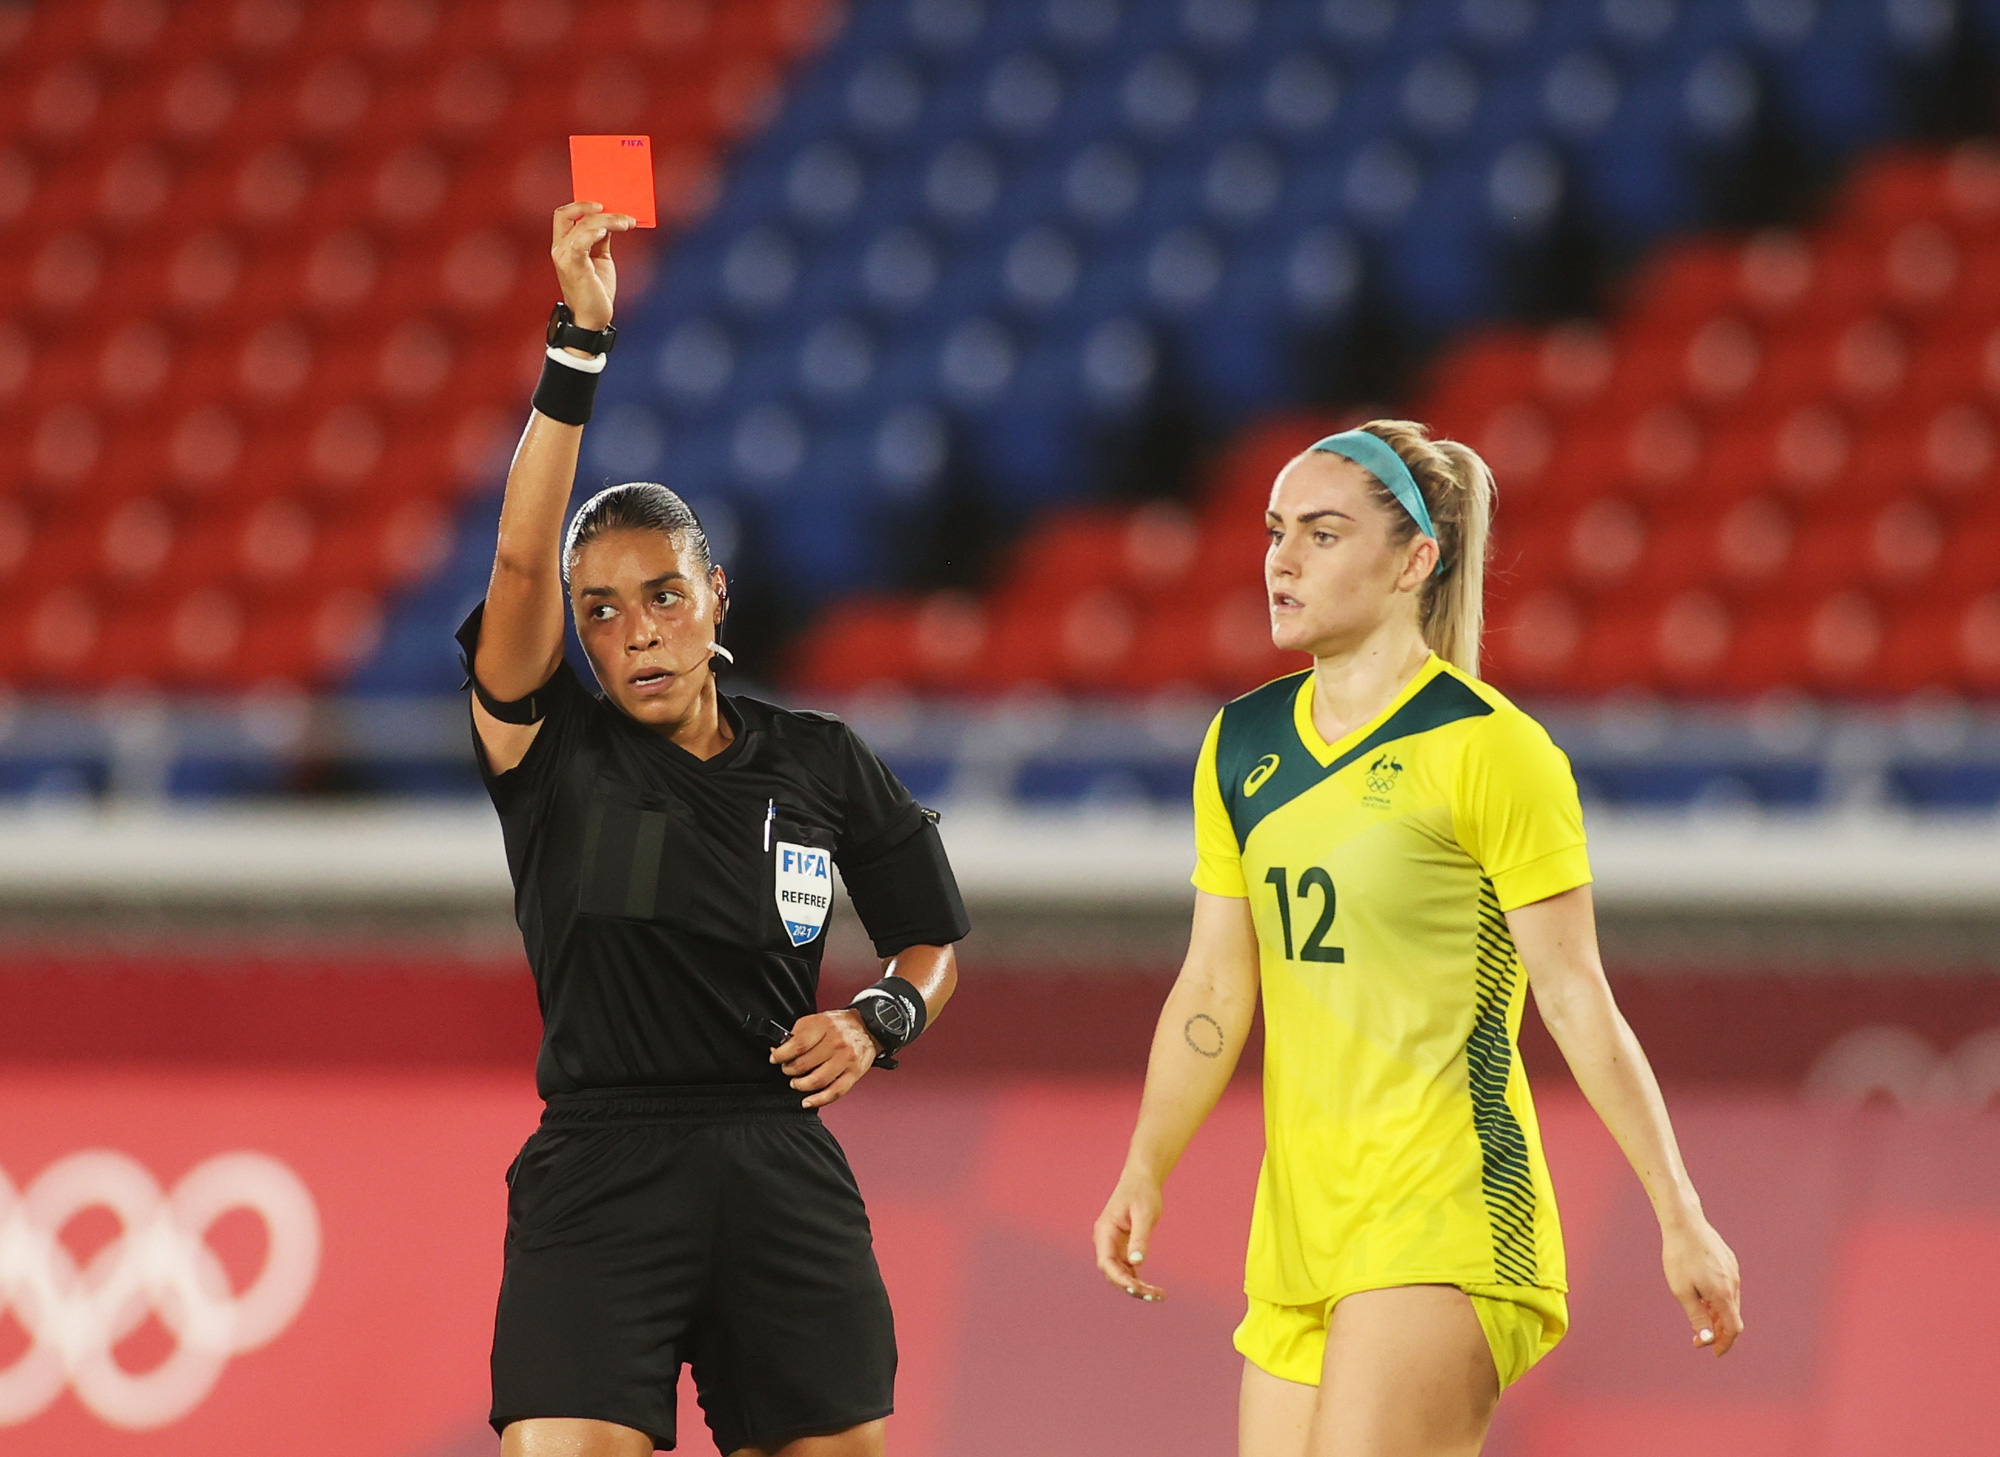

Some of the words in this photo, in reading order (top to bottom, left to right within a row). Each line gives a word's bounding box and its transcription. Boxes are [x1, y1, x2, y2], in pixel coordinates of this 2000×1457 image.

[783, 850, 827, 879] FIFA
[782, 890, 827, 908] REFEREE
[1264, 866, 1345, 964] 12
